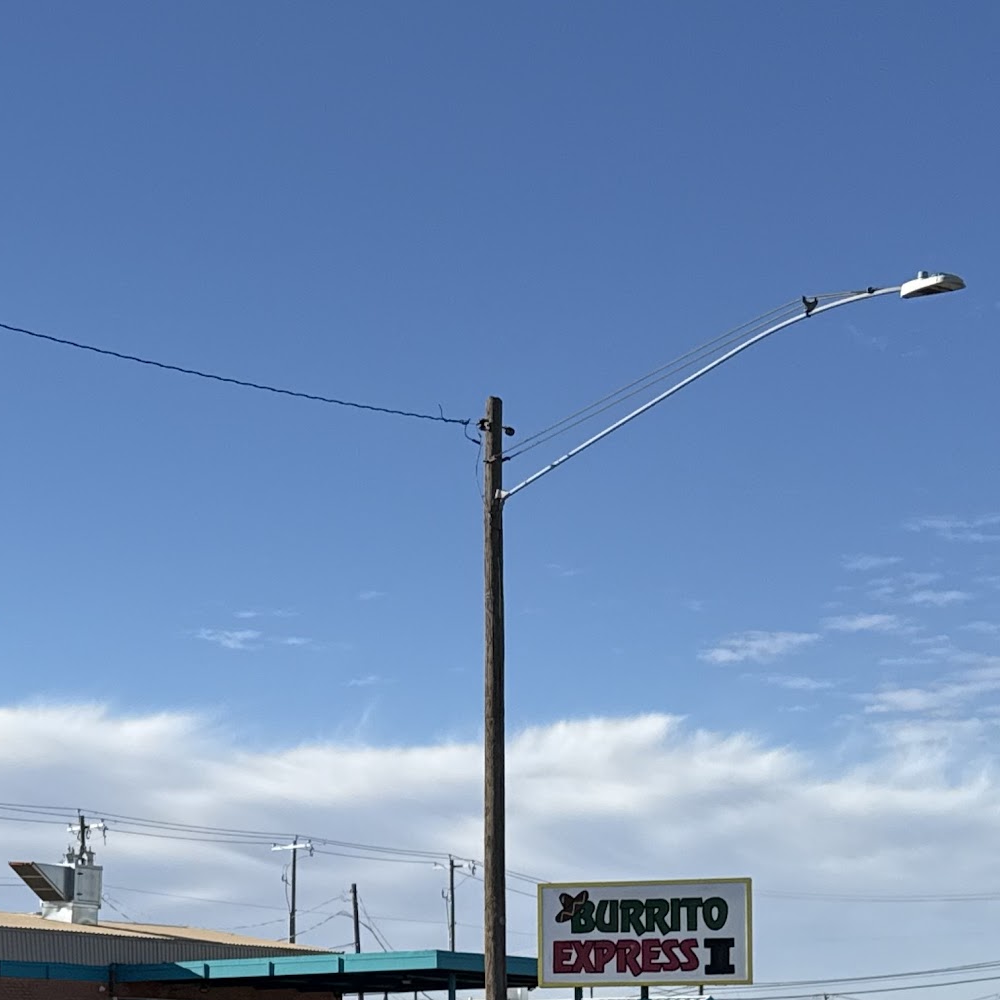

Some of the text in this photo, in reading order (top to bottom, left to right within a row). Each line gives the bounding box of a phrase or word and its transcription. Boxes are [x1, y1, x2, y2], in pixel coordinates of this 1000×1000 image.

[571, 897, 728, 936] BURRITO
[553, 937, 735, 977] EXPRESS I
